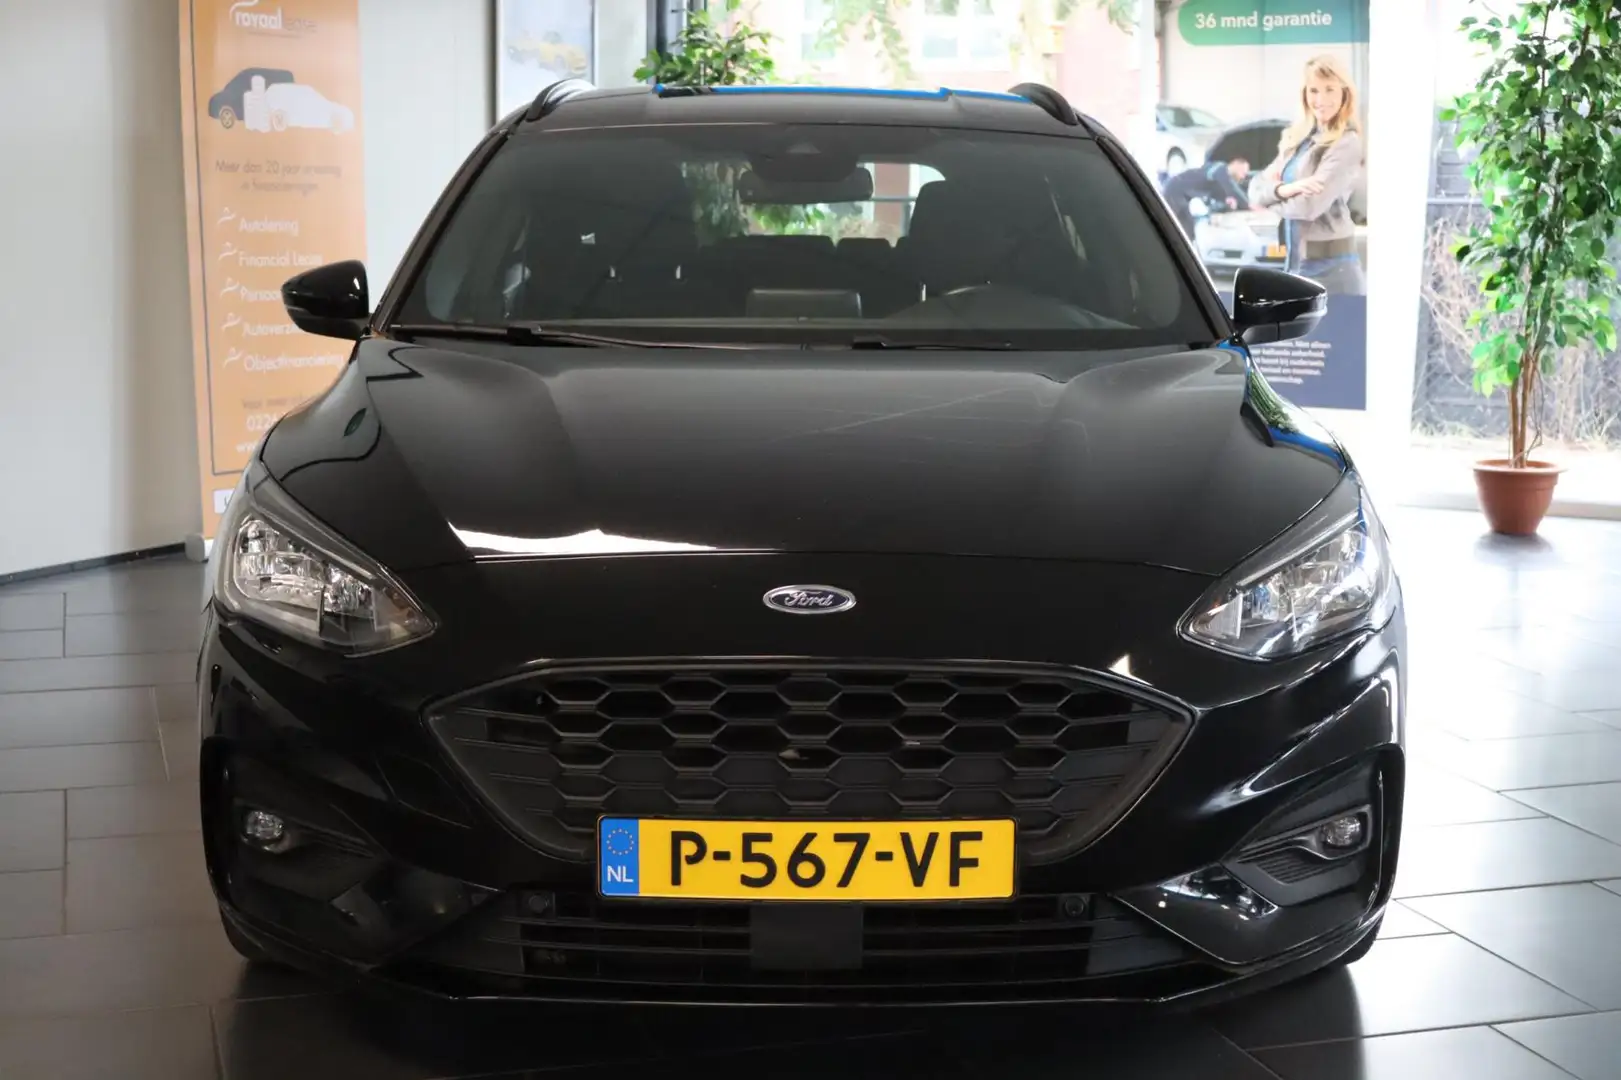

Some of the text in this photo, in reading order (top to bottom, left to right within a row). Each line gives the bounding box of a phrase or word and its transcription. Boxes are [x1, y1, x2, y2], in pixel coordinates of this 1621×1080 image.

[1195, 9, 1333, 31] 36 mnd garantie
[239, 250, 290, 267] Financial
[784, 591, 835, 607] Ford
[607, 831, 983, 888] NL P-567-VF
